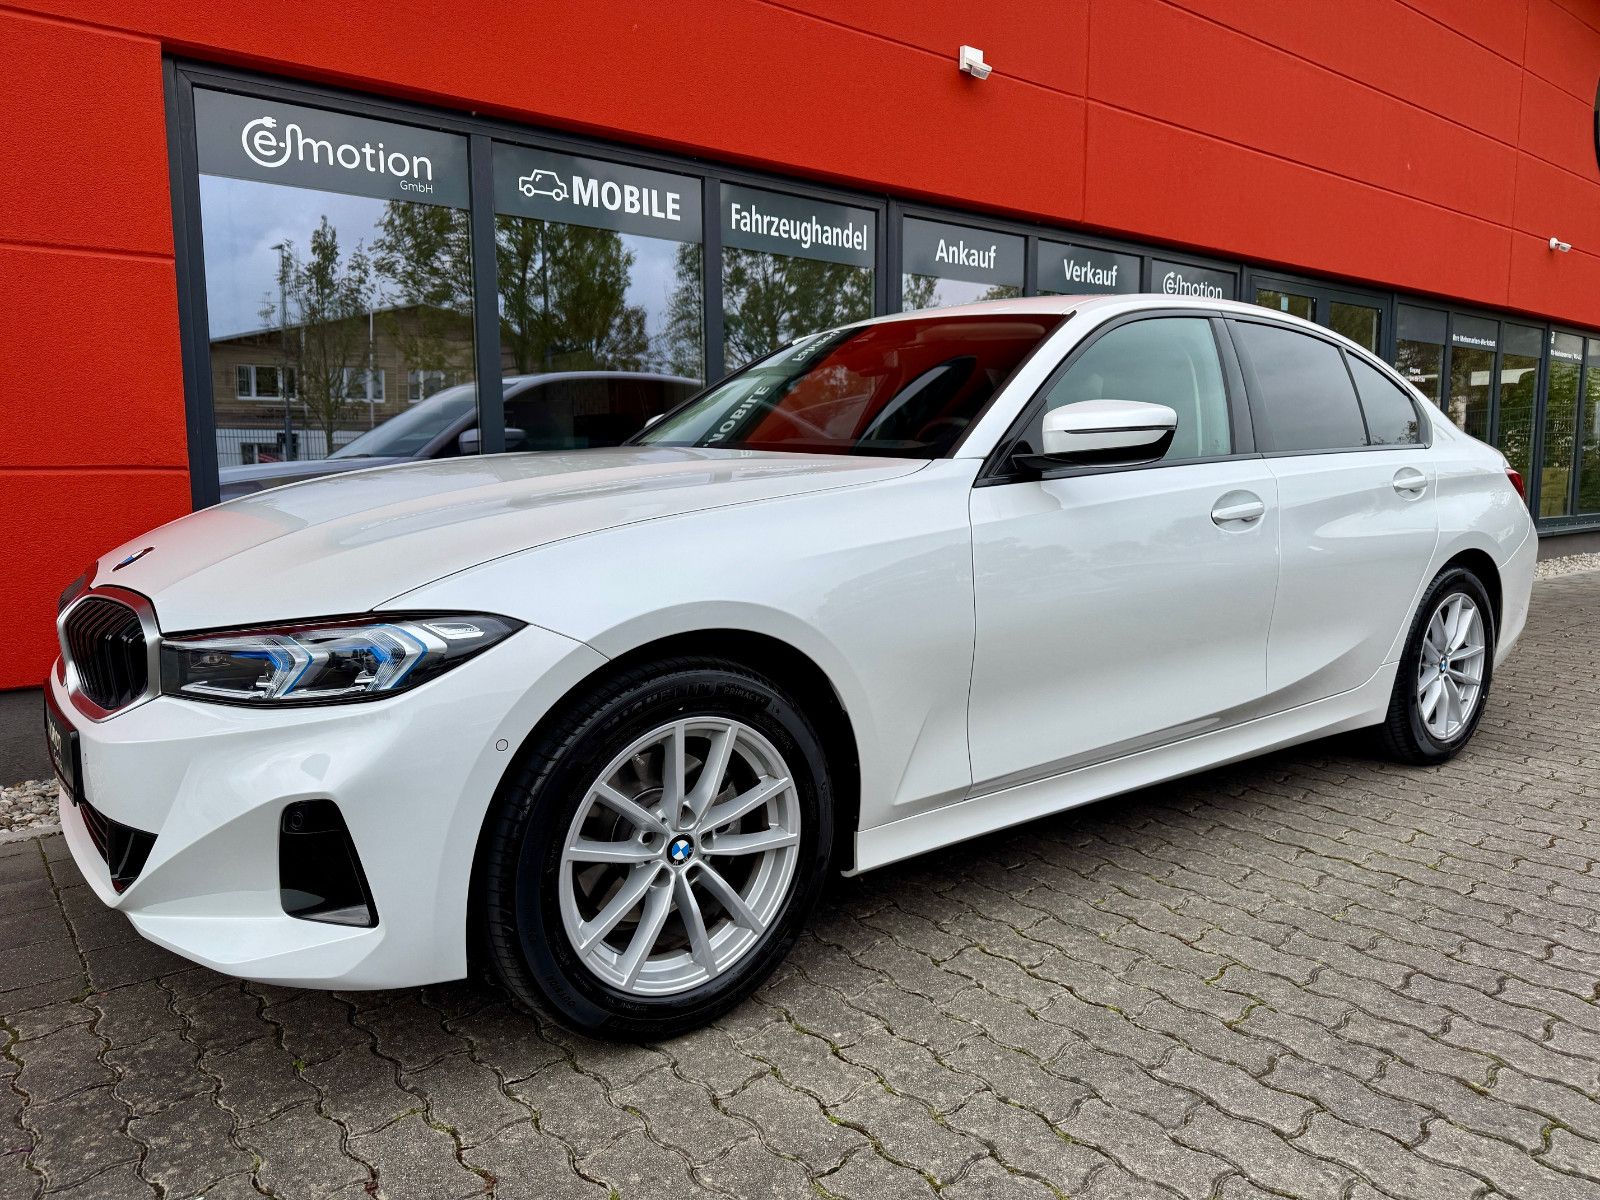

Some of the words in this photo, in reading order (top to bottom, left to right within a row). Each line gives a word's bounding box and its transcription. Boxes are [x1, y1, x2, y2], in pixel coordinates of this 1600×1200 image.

[399, 179, 434, 195] GmbH
[572, 175, 682, 222] MOBILE
[730, 202, 868, 252] Fahrzeughandel
[935, 238, 997, 271] Ankauf
[1063, 258, 1118, 288] Verkauf
